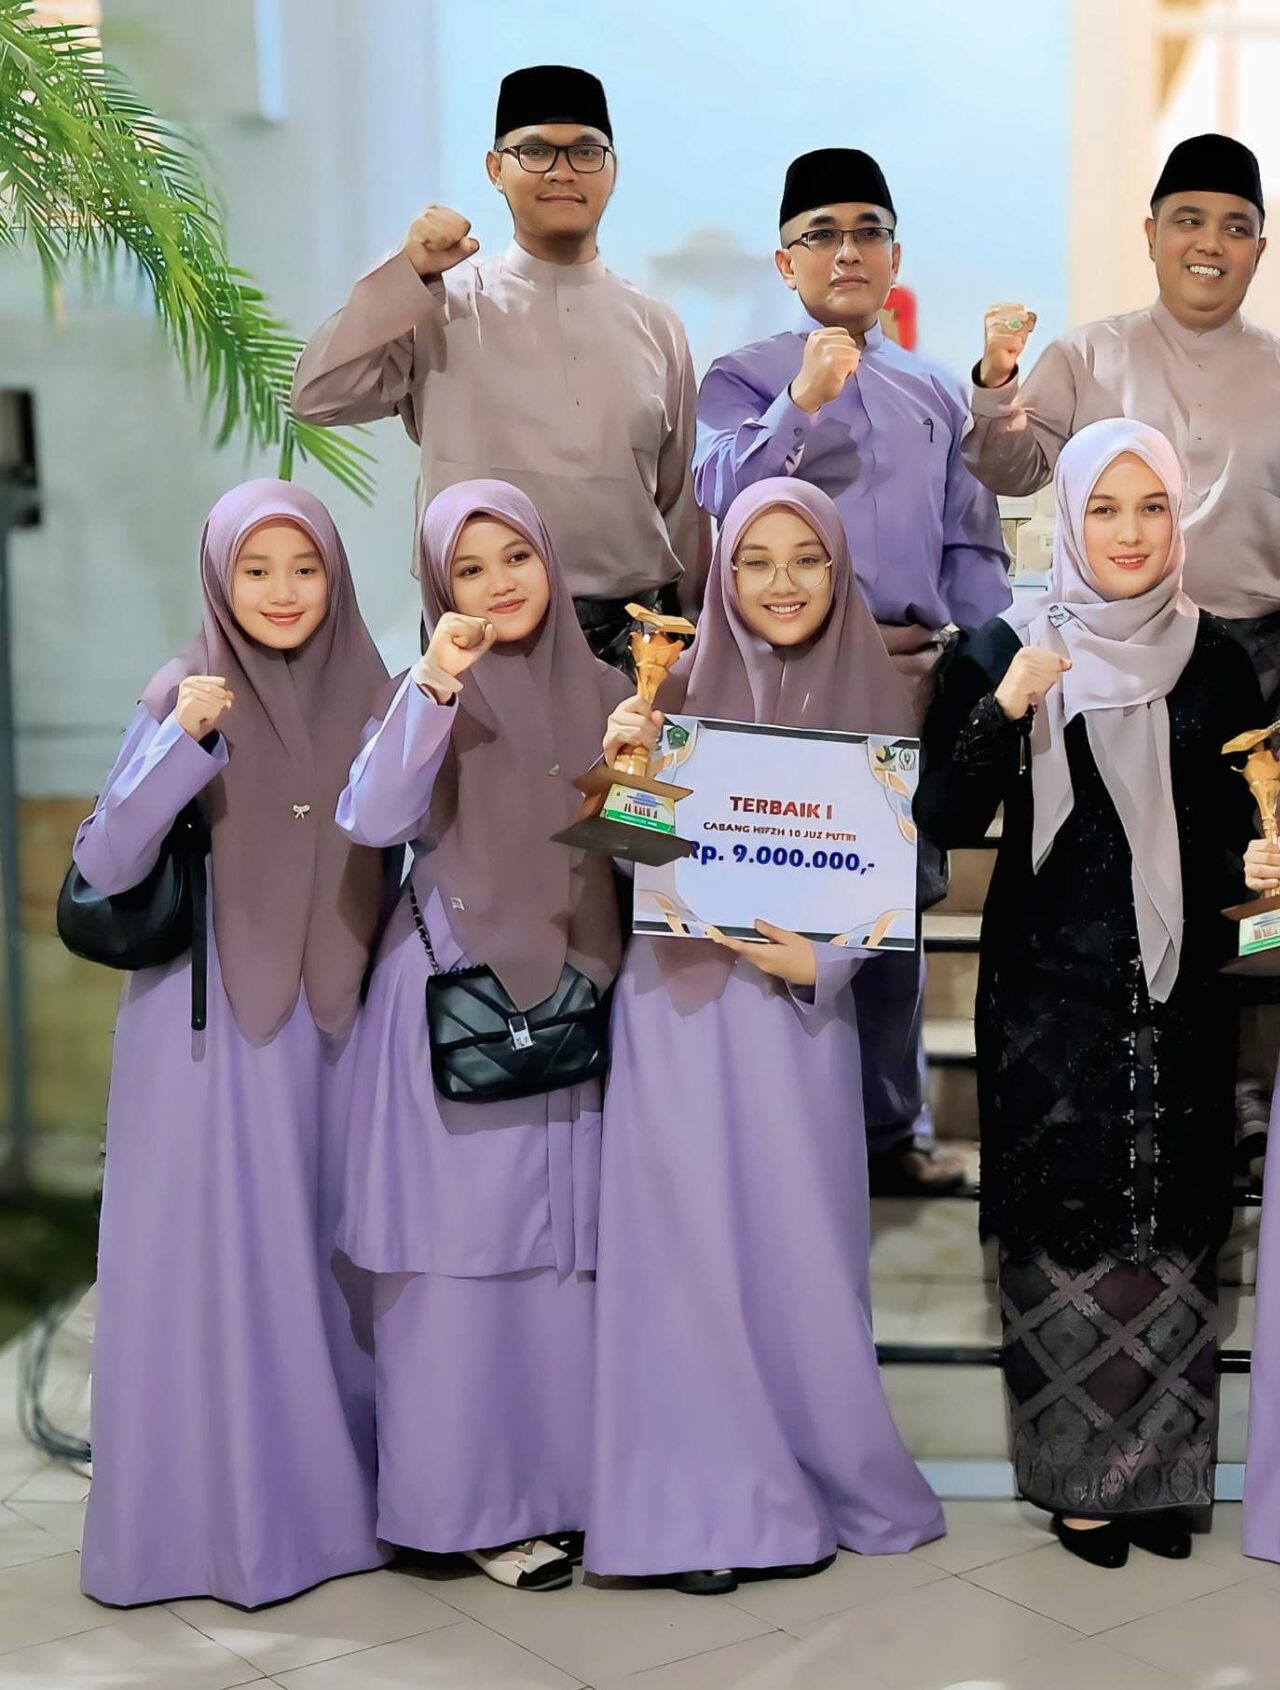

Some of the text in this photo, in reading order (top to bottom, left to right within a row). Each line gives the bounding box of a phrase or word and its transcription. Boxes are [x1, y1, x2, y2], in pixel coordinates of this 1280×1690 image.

[730, 796, 832, 819] TERBAIK I
[704, 822, 749, 833] CABANG
[804, 831, 822, 839] JUZ
[733, 844, 875, 875] 9.000.000,-
